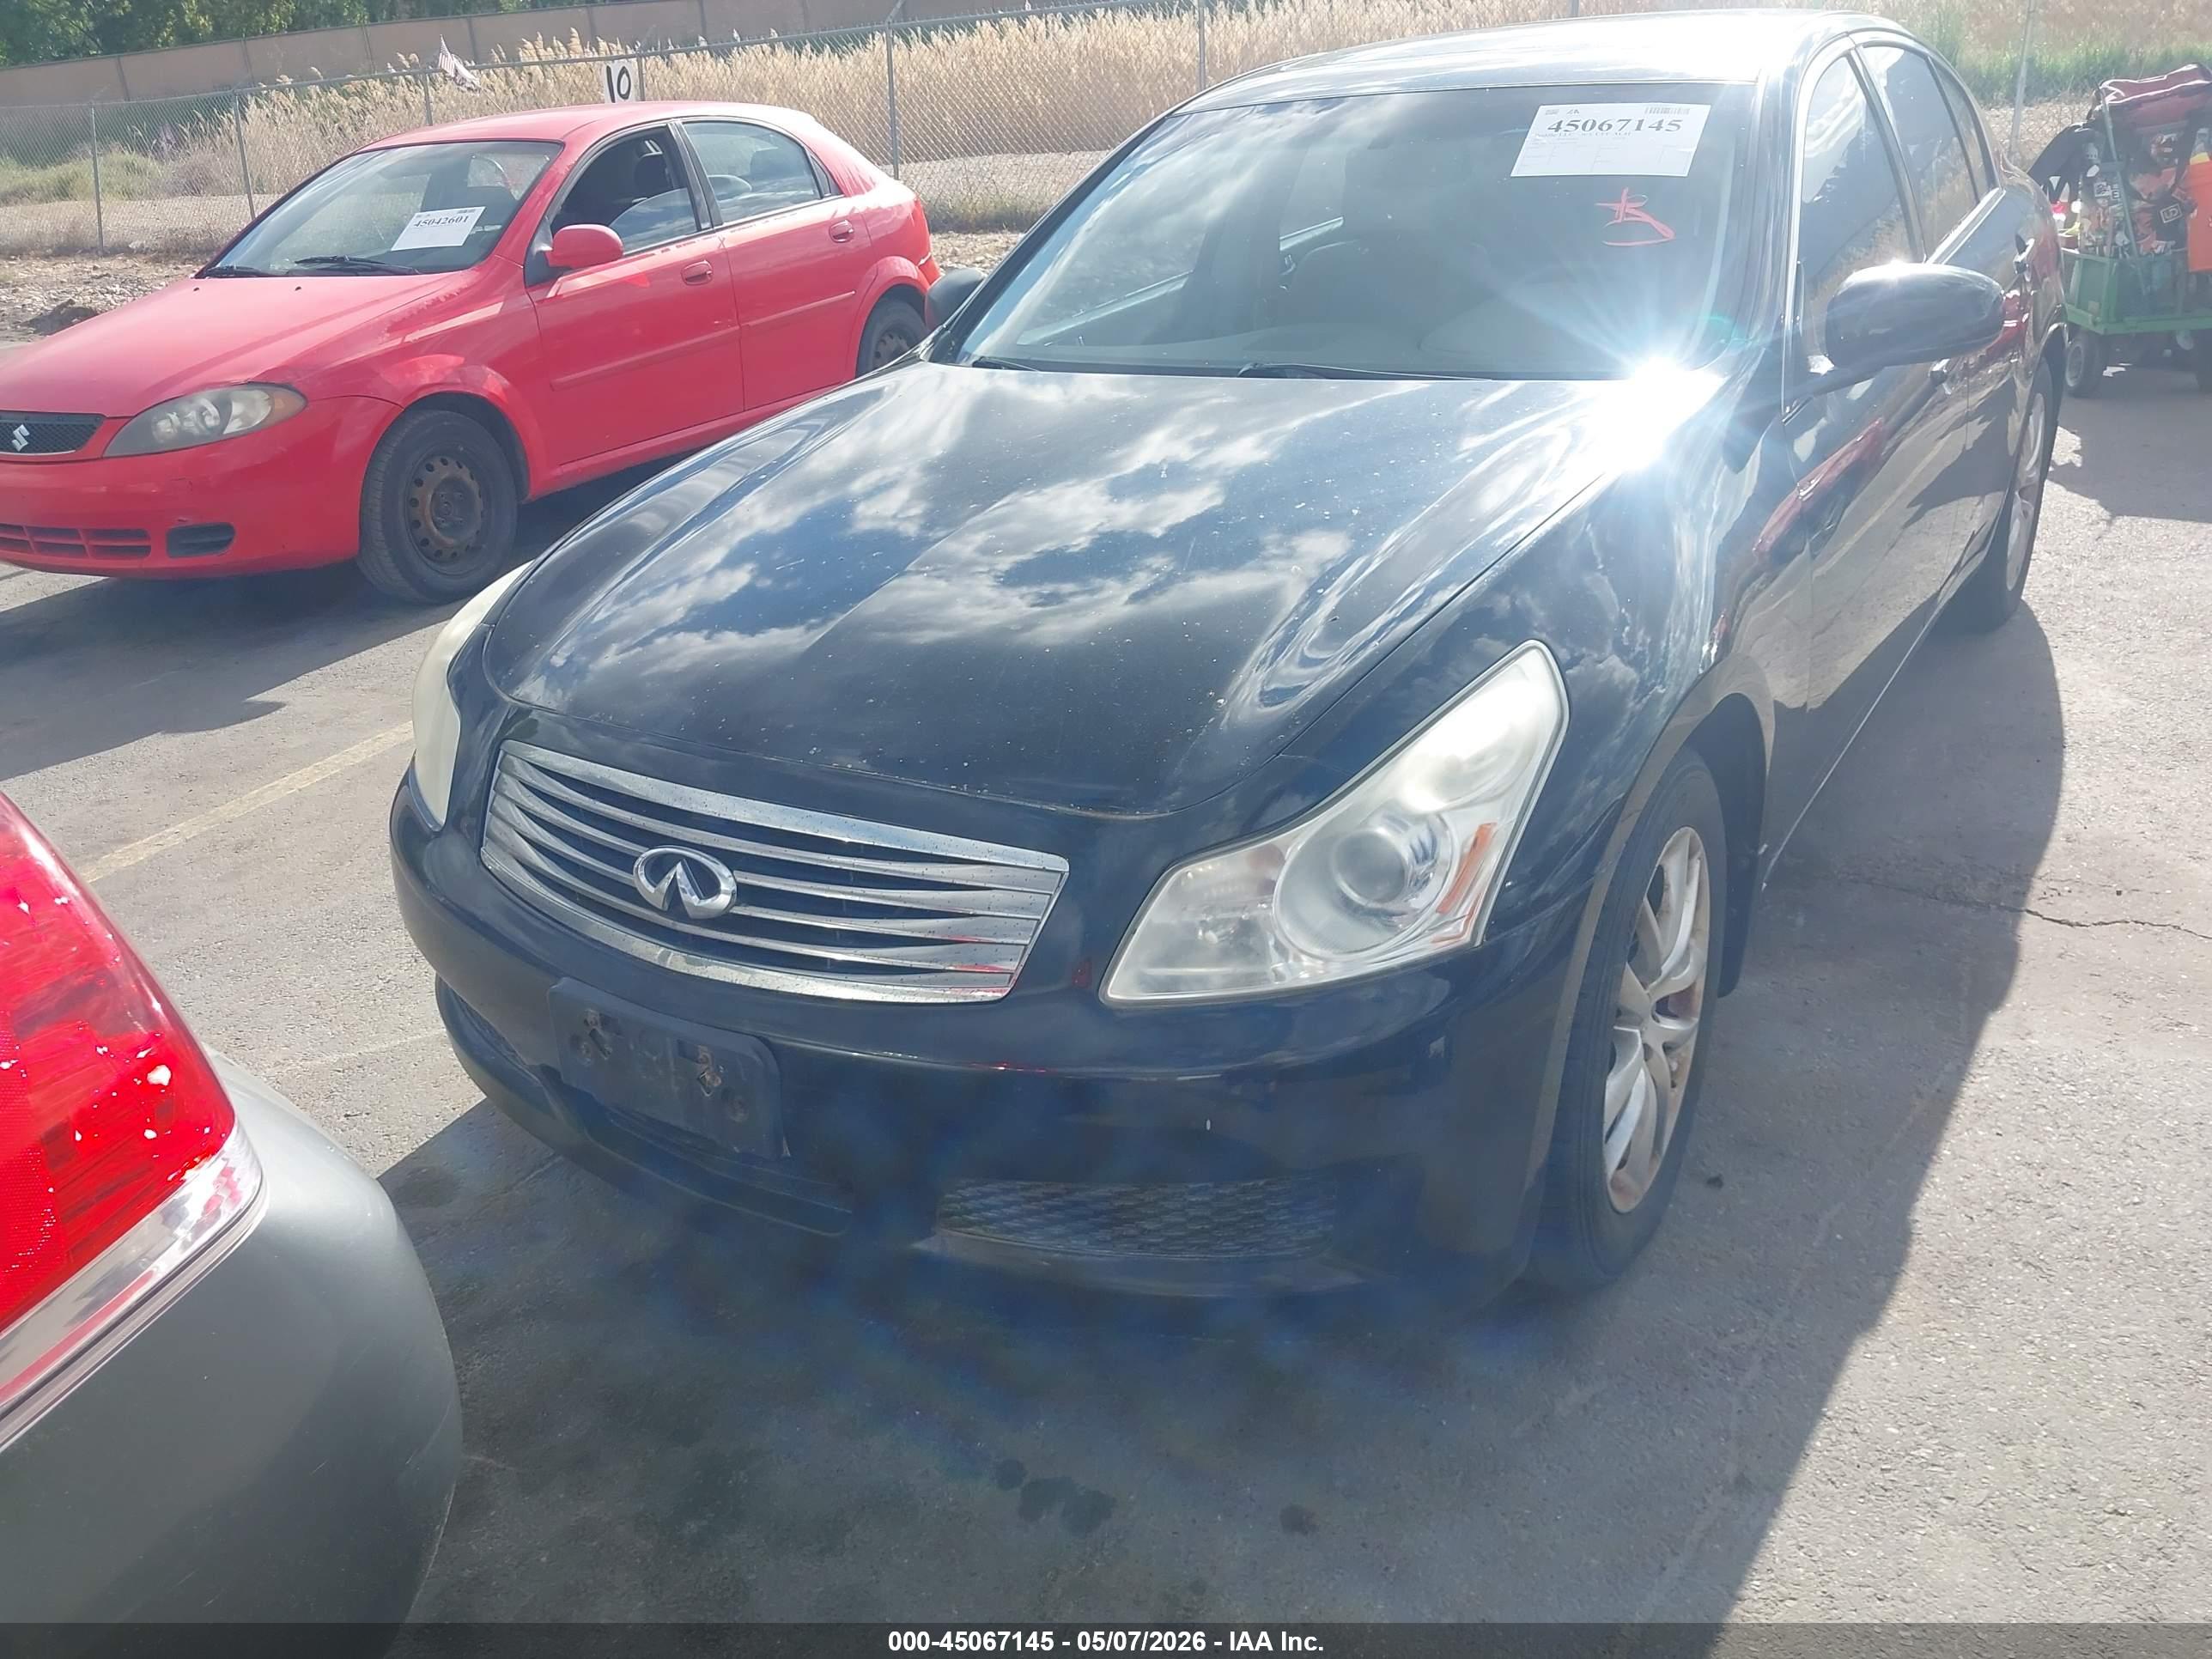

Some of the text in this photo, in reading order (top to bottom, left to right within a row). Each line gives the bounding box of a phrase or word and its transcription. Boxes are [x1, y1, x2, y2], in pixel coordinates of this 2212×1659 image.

[606, 65, 631, 103] 10
[1547, 118, 1683, 133] 45067145
[414, 216, 469, 227] 45042601
